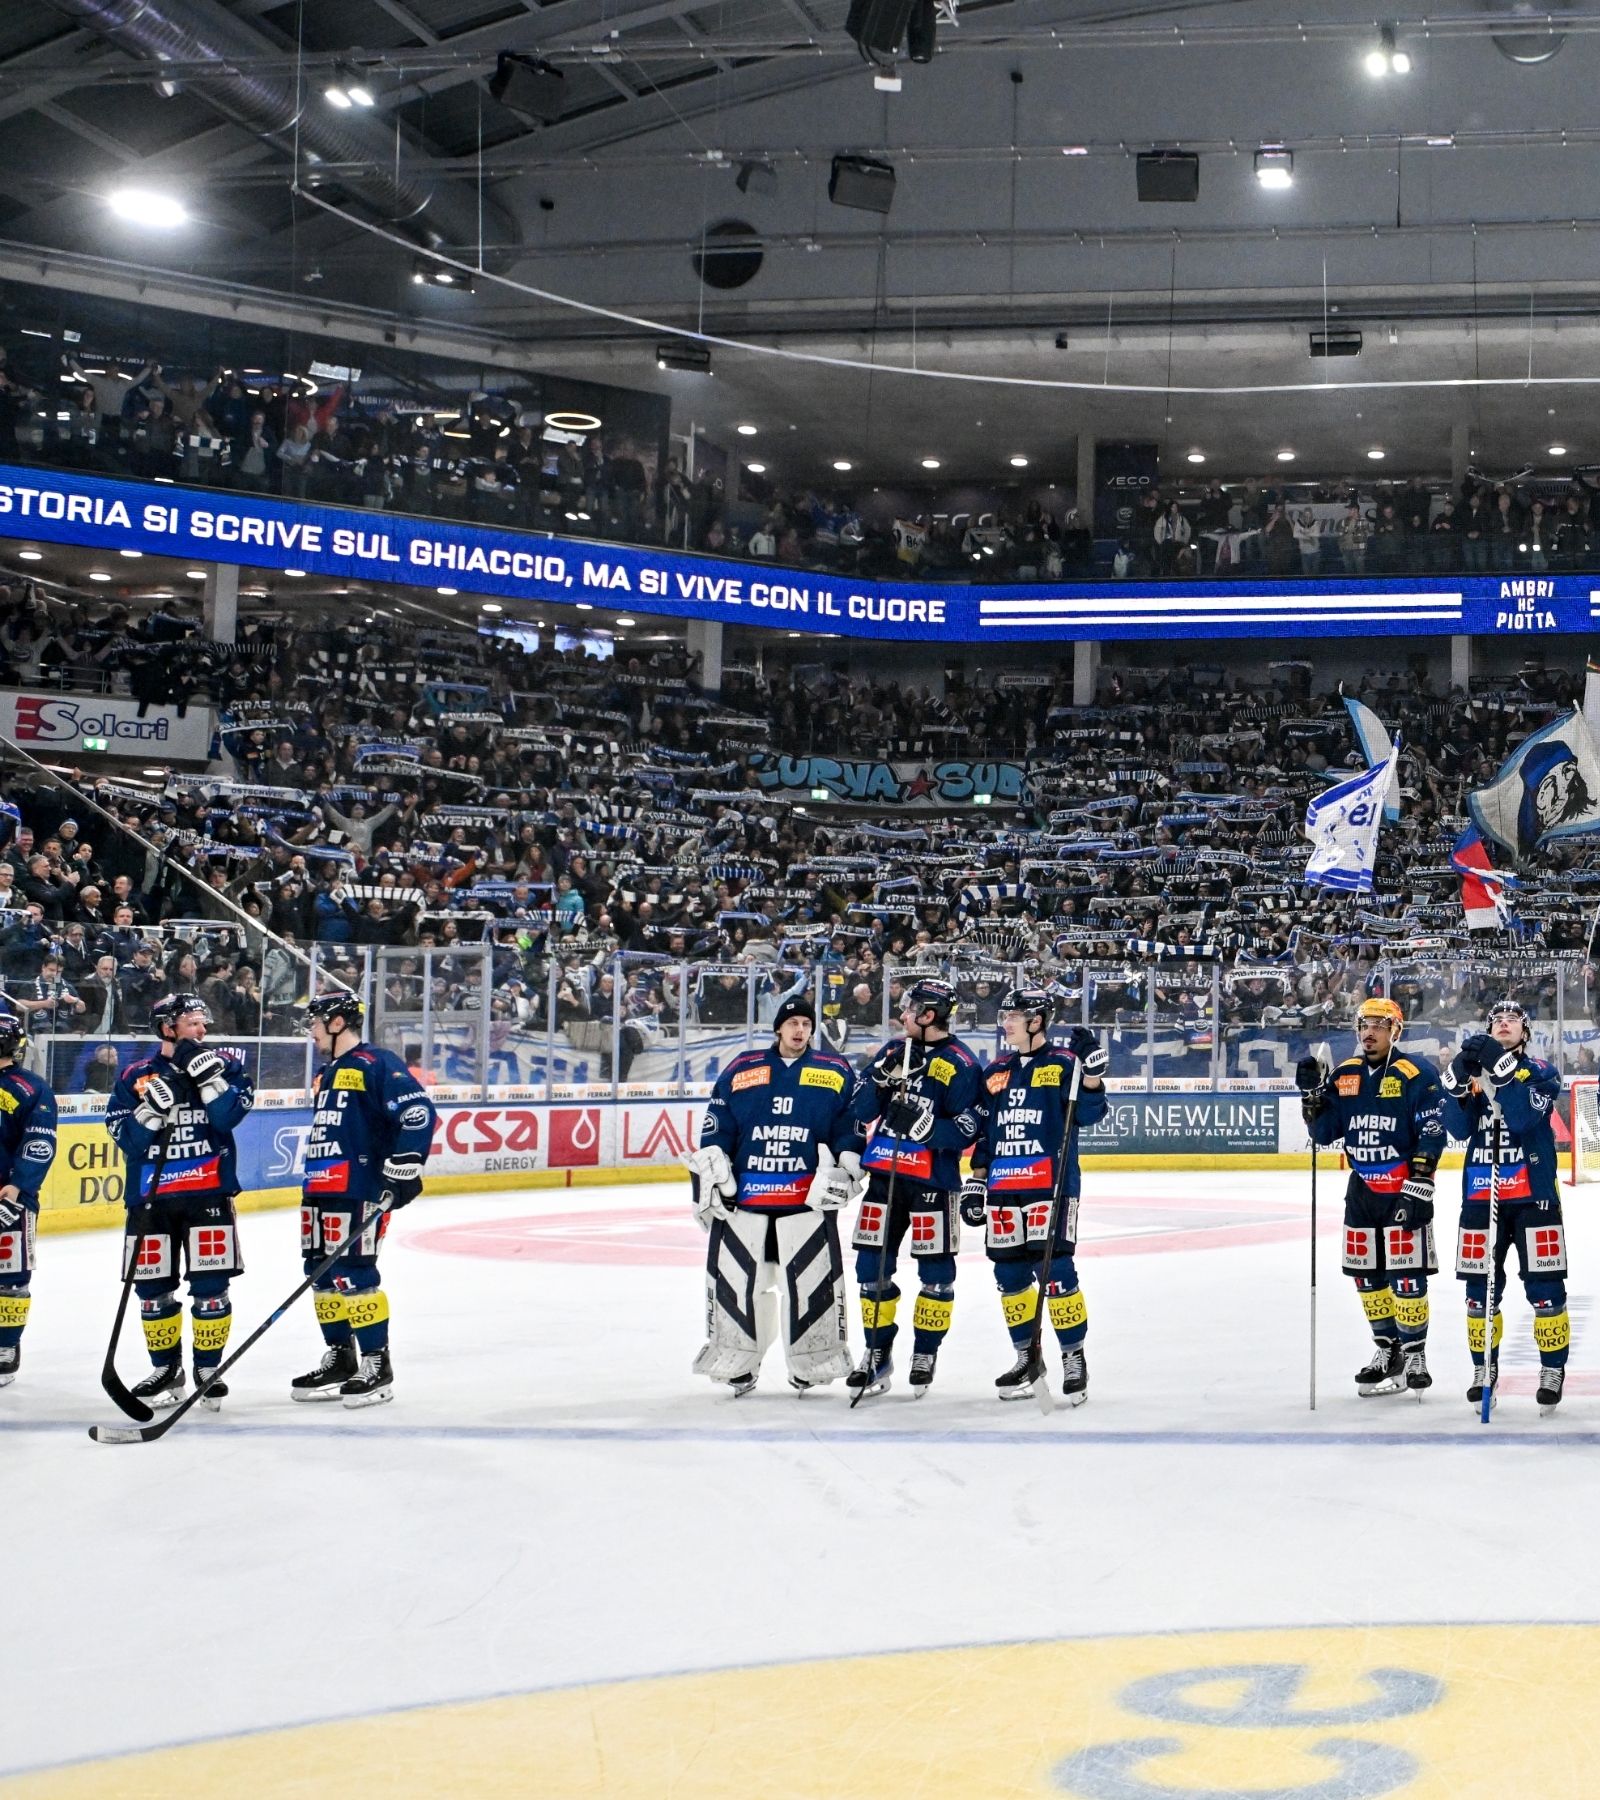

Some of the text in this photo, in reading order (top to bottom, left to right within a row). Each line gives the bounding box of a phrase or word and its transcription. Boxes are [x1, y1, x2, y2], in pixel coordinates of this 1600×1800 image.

[143, 504, 177, 533] SI
[190, 510, 322, 552] SCRIVE
[333, 529, 399, 562] SUL
[410, 538, 573, 587] GHIACCIO,
[582, 561, 631, 591] MA
[639, 569, 667, 595] SI
[676, 574, 742, 604] VIVE
[750, 583, 808, 612] CON
[818, 592, 840, 617] IL
[848, 595, 946, 624] CUORE
[1499, 581, 1554, 600] AMBRI
[1517, 598, 1536, 612] HC
[1496, 612, 1557, 630] PIOTTA
[36, 700, 169, 741] Solari
[748, 753, 1026, 799] CURVA SUD
[337, 1091, 348, 1108] C
[771, 1096, 794, 1115] 30
[1009, 1088, 1027, 1107] 59
[996, 1109, 1043, 1125] AMBRI
[1145, 1105, 1275, 1127] NEWLINE
[1348, 1115, 1397, 1132] AMBRI
[170, 1126, 194, 1141] HC
[751, 1125, 810, 1143] AMBRI
[1005, 1124, 1026, 1139] HC
[1145, 1128, 1275, 1137] TUTTA UN'ALTRA CASA
[1358, 1130, 1380, 1146] HC
[148, 1139, 213, 1160] POTTA
[765, 1141, 790, 1156] HC
[872, 1145, 921, 1164] ADMRAL
[995, 1139, 1044, 1156] PIOTTA
[68, 1143, 119, 1170] CHI
[485, 1157, 537, 1171] ENERGY
[747, 1156, 807, 1172] PIOTTA
[991, 1166, 1037, 1178] ADMIRAL
[80, 1174, 124, 1204] D'O
[743, 1182, 801, 1192] ADMIRAL
[993, 1236, 1009, 1244] Studio
[198, 1257, 219, 1267] Studio
[1461, 1261, 1477, 1270] Studio
[1536, 1259, 1554, 1267] Studio
[707, 1287, 715, 1340] TRUE
[837, 1290, 846, 1342] TRUE
